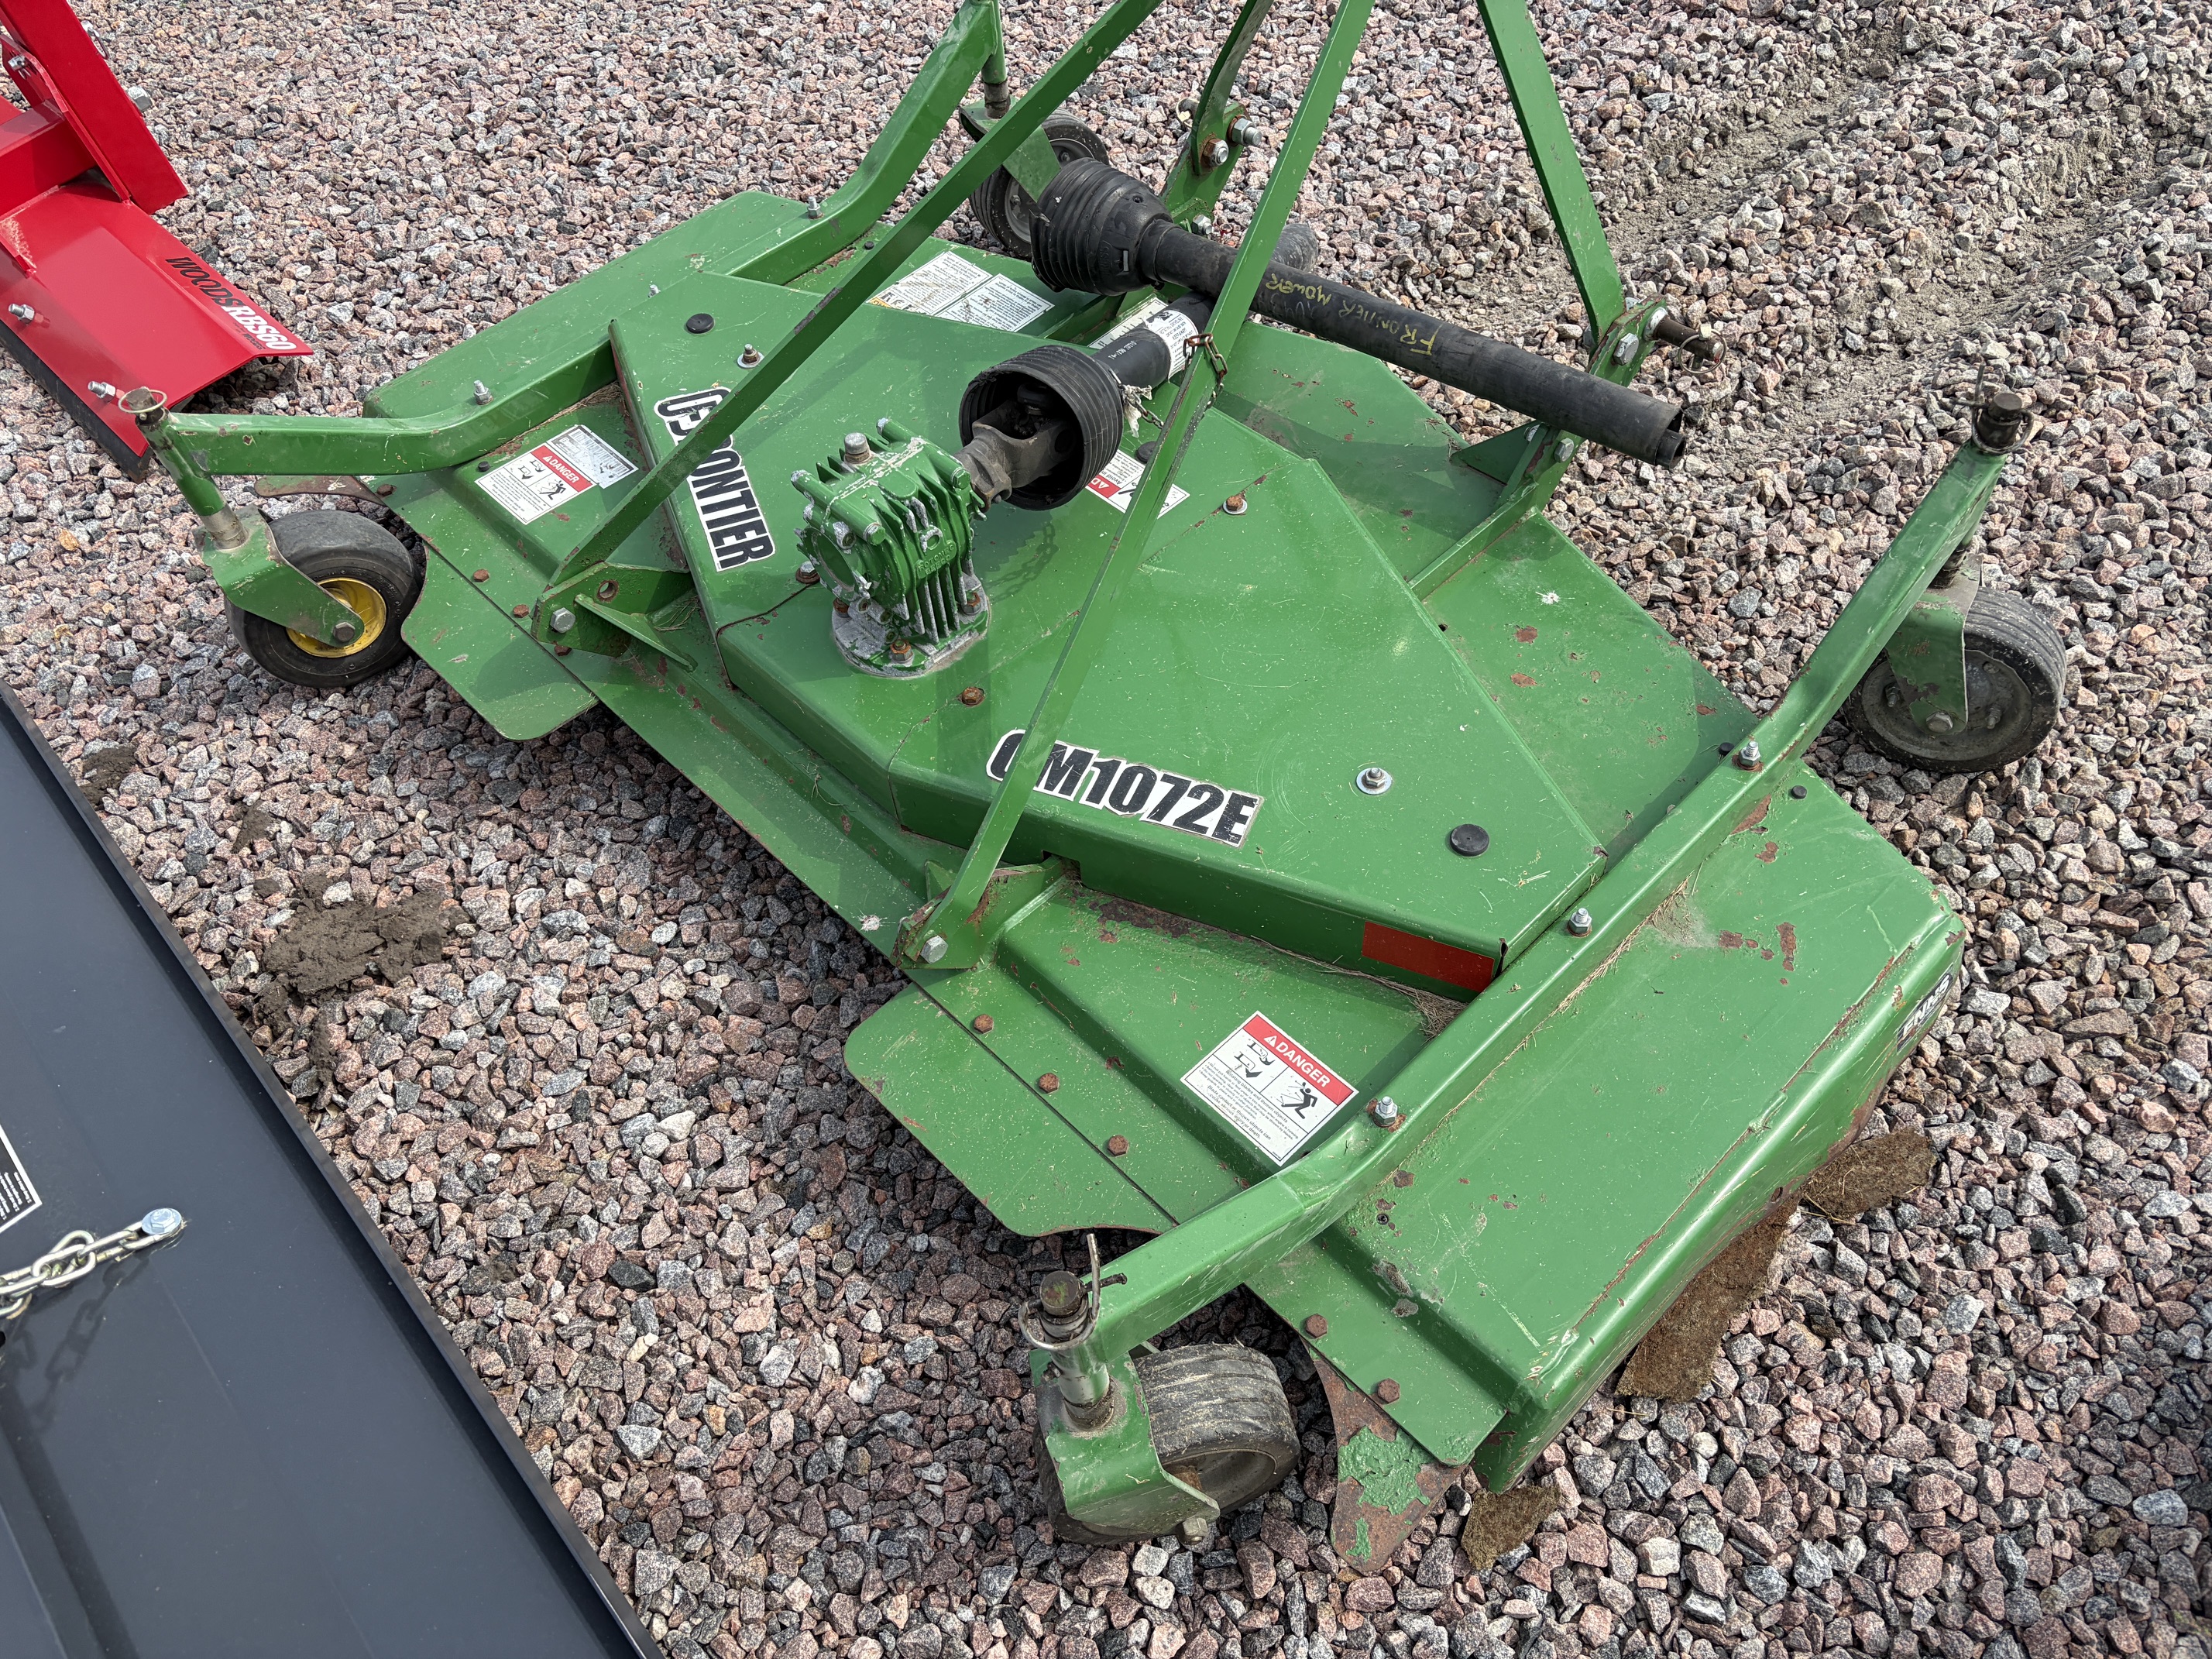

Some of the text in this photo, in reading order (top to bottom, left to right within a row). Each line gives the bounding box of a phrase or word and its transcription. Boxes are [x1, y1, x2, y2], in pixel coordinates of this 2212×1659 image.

[165, 257, 297, 350] WOODS RBS60
[1266, 273, 1332, 307] MOWER
[548, 459, 580, 483] DANGER
[1275, 1041, 1331, 1087] DANGER
